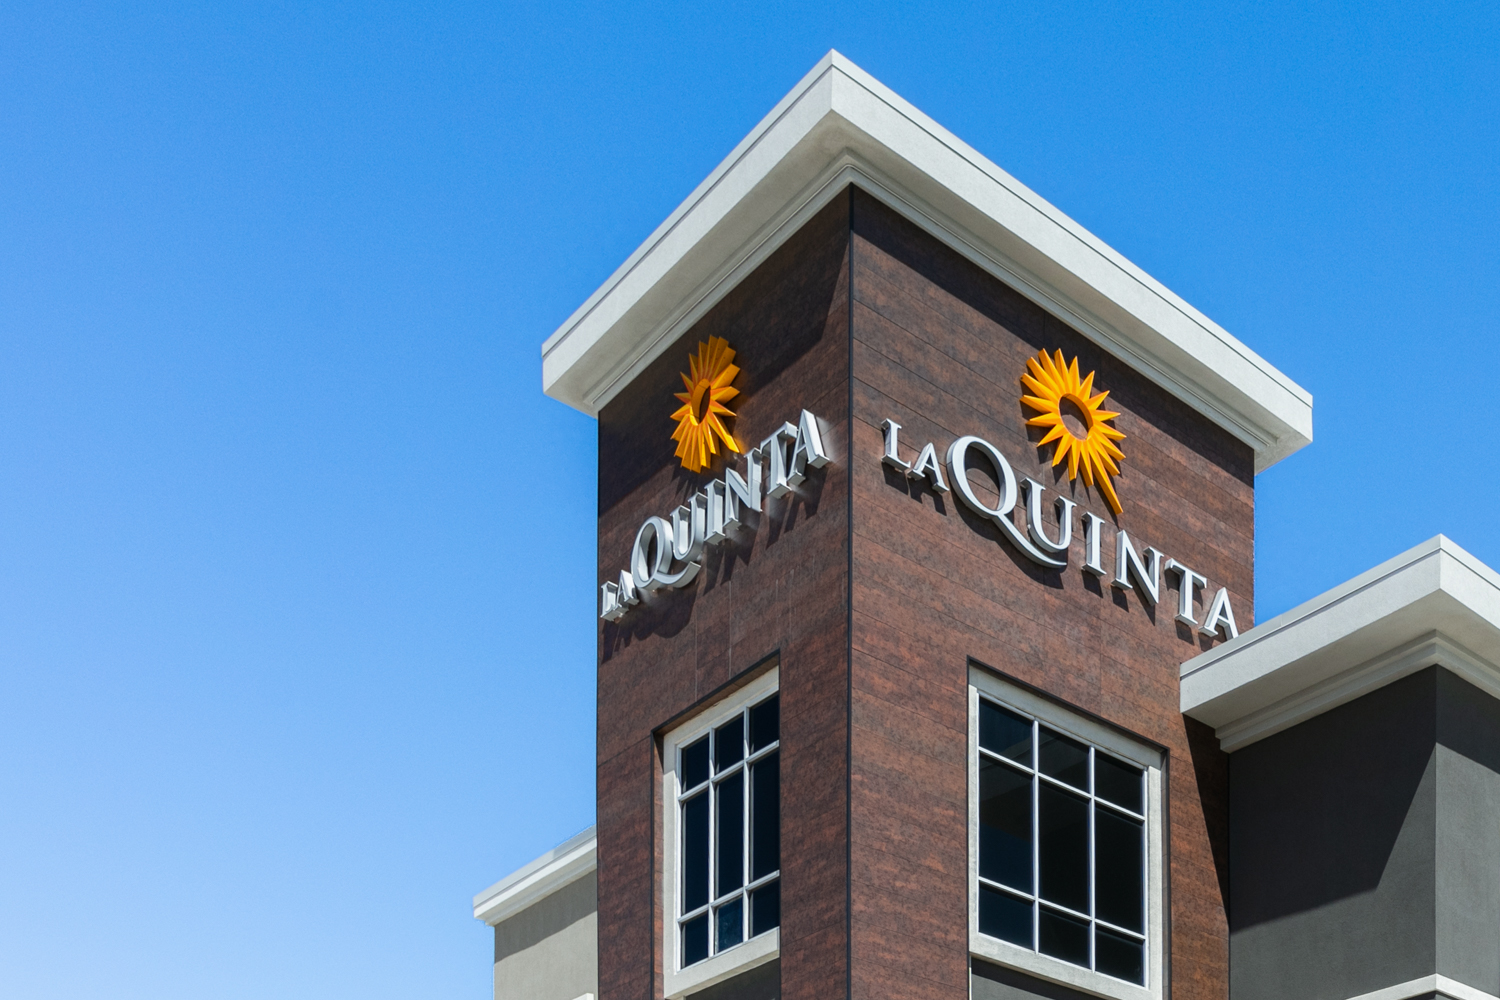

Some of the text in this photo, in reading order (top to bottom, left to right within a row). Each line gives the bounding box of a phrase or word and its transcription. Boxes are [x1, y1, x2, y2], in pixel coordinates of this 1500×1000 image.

[601, 409, 829, 621] LA QUINTA
[881, 418, 1238, 639] LA QUINTA
